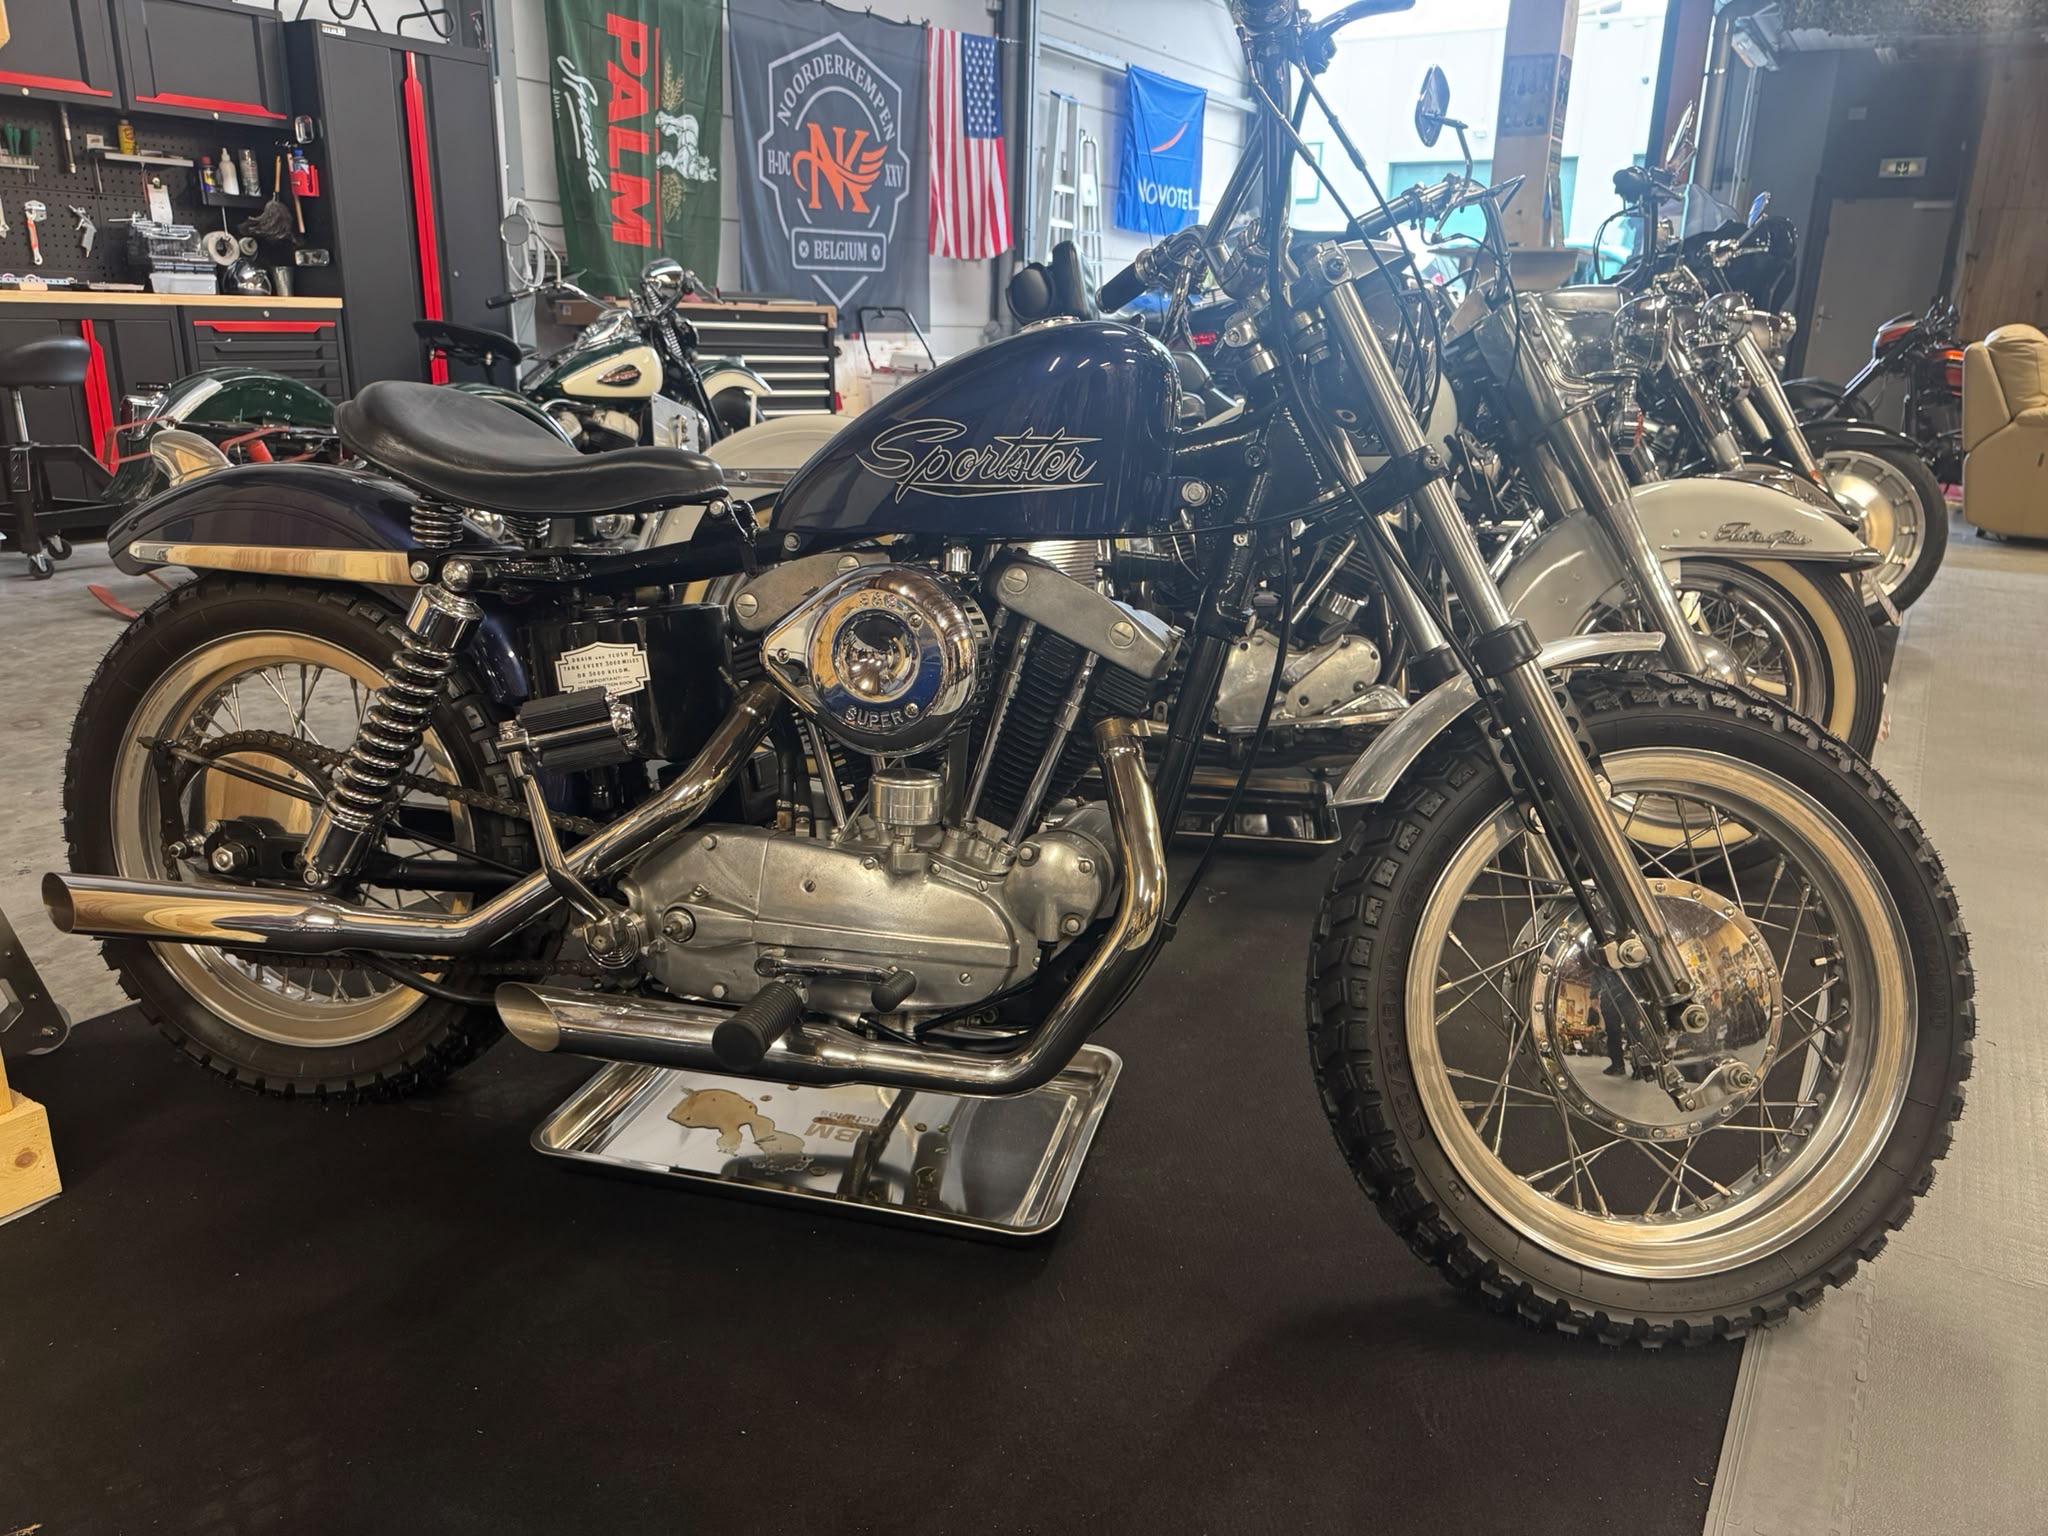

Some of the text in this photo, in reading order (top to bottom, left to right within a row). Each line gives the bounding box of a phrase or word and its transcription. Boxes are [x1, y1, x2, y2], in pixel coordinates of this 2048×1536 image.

[776, 53, 896, 142] NOORDERKEMPEN
[556, 55, 608, 193] Speciale
[606, 12, 652, 248] PALM
[884, 163, 904, 188] XXV
[1137, 178, 1200, 211] NOVOTEL
[813, 239, 868, 262] BELGIUM
[855, 418, 1104, 504] Sportster
[563, 664, 581, 672] TANK
[583, 662, 603, 670] EVERY
[571, 655, 593, 663] DRAIN
[608, 651, 629, 659] FLUSH
[844, 704, 905, 728] SUPER
